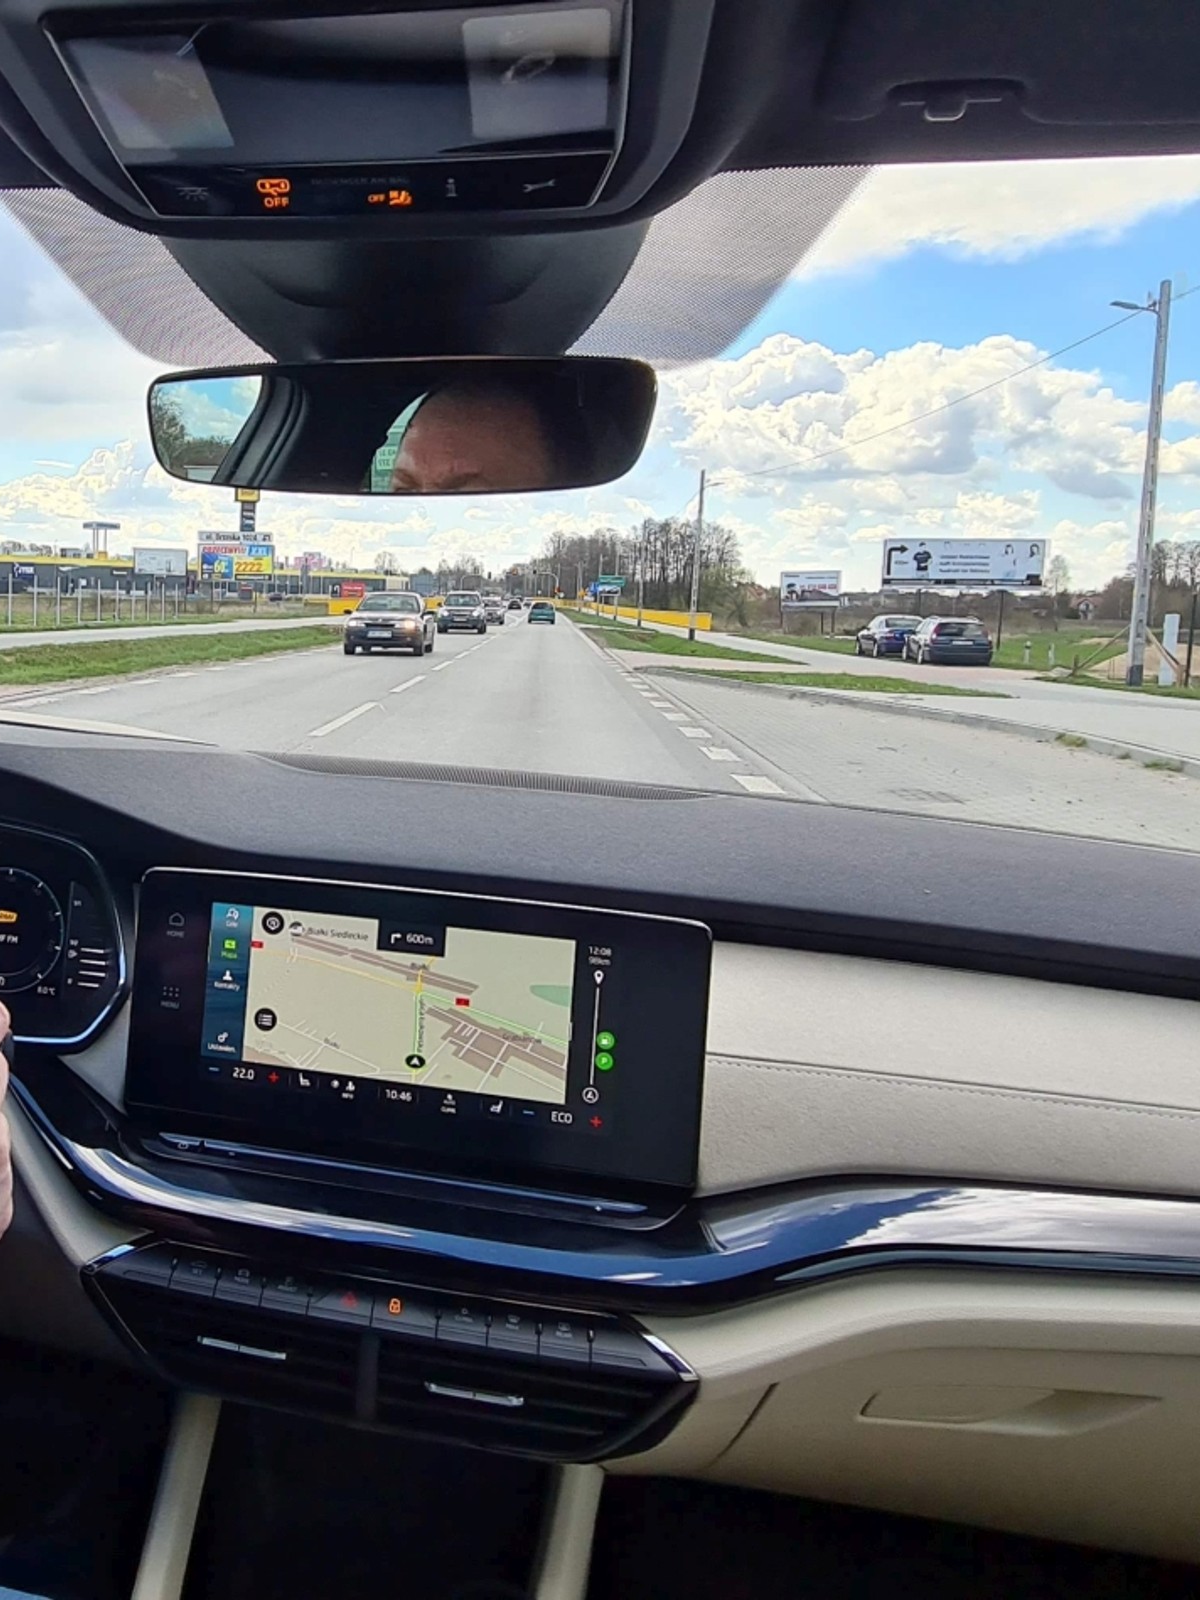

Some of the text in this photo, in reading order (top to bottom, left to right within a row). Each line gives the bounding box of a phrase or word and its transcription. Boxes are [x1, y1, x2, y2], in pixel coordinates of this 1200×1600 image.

[264, 197, 290, 208] OFF
[406, 933, 434, 946] 600m
[232, 1066, 255, 1080] 22.0
[385, 1088, 412, 1102] 10:46
[551, 1110, 573, 1125] ECO
